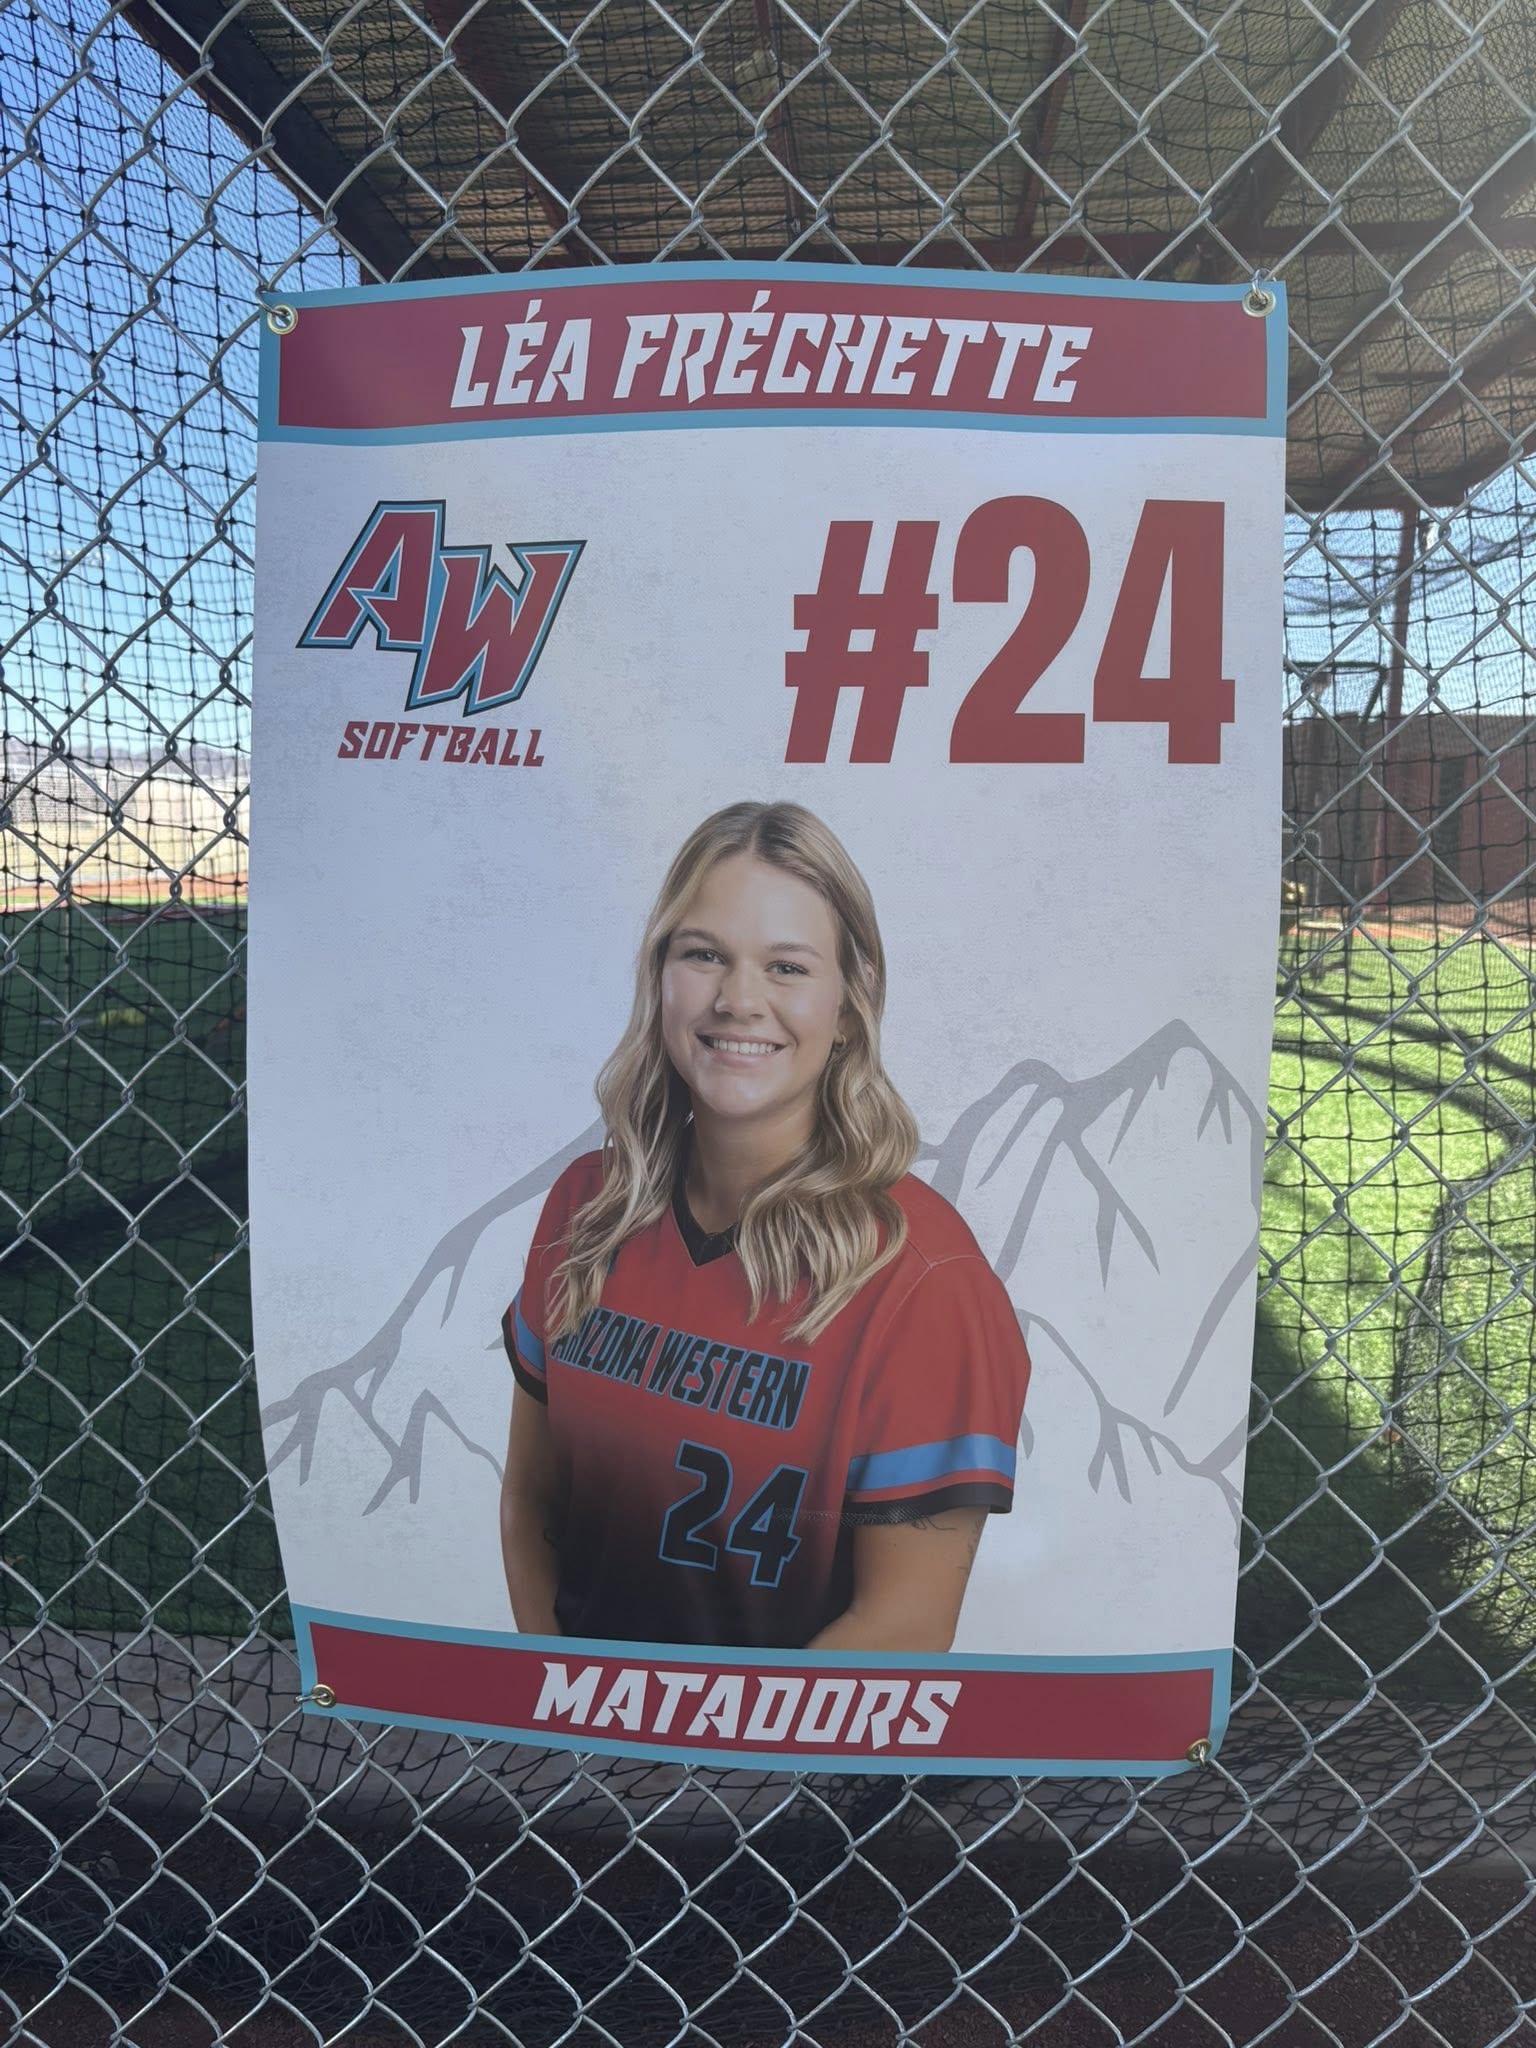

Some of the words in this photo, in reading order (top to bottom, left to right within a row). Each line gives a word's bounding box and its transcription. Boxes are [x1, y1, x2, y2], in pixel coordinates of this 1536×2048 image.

[450, 299, 592, 408] LÉA
[612, 289, 1093, 403] FRÉCHETTE
[296, 499, 588, 717] AW
[784, 495, 1236, 764] #24
[337, 721, 545, 767] SOFTBALL
[646, 1328, 812, 1431] WESTERN
[660, 1440, 810, 1588] 24
[533, 1662, 962, 1750] MATADORS
